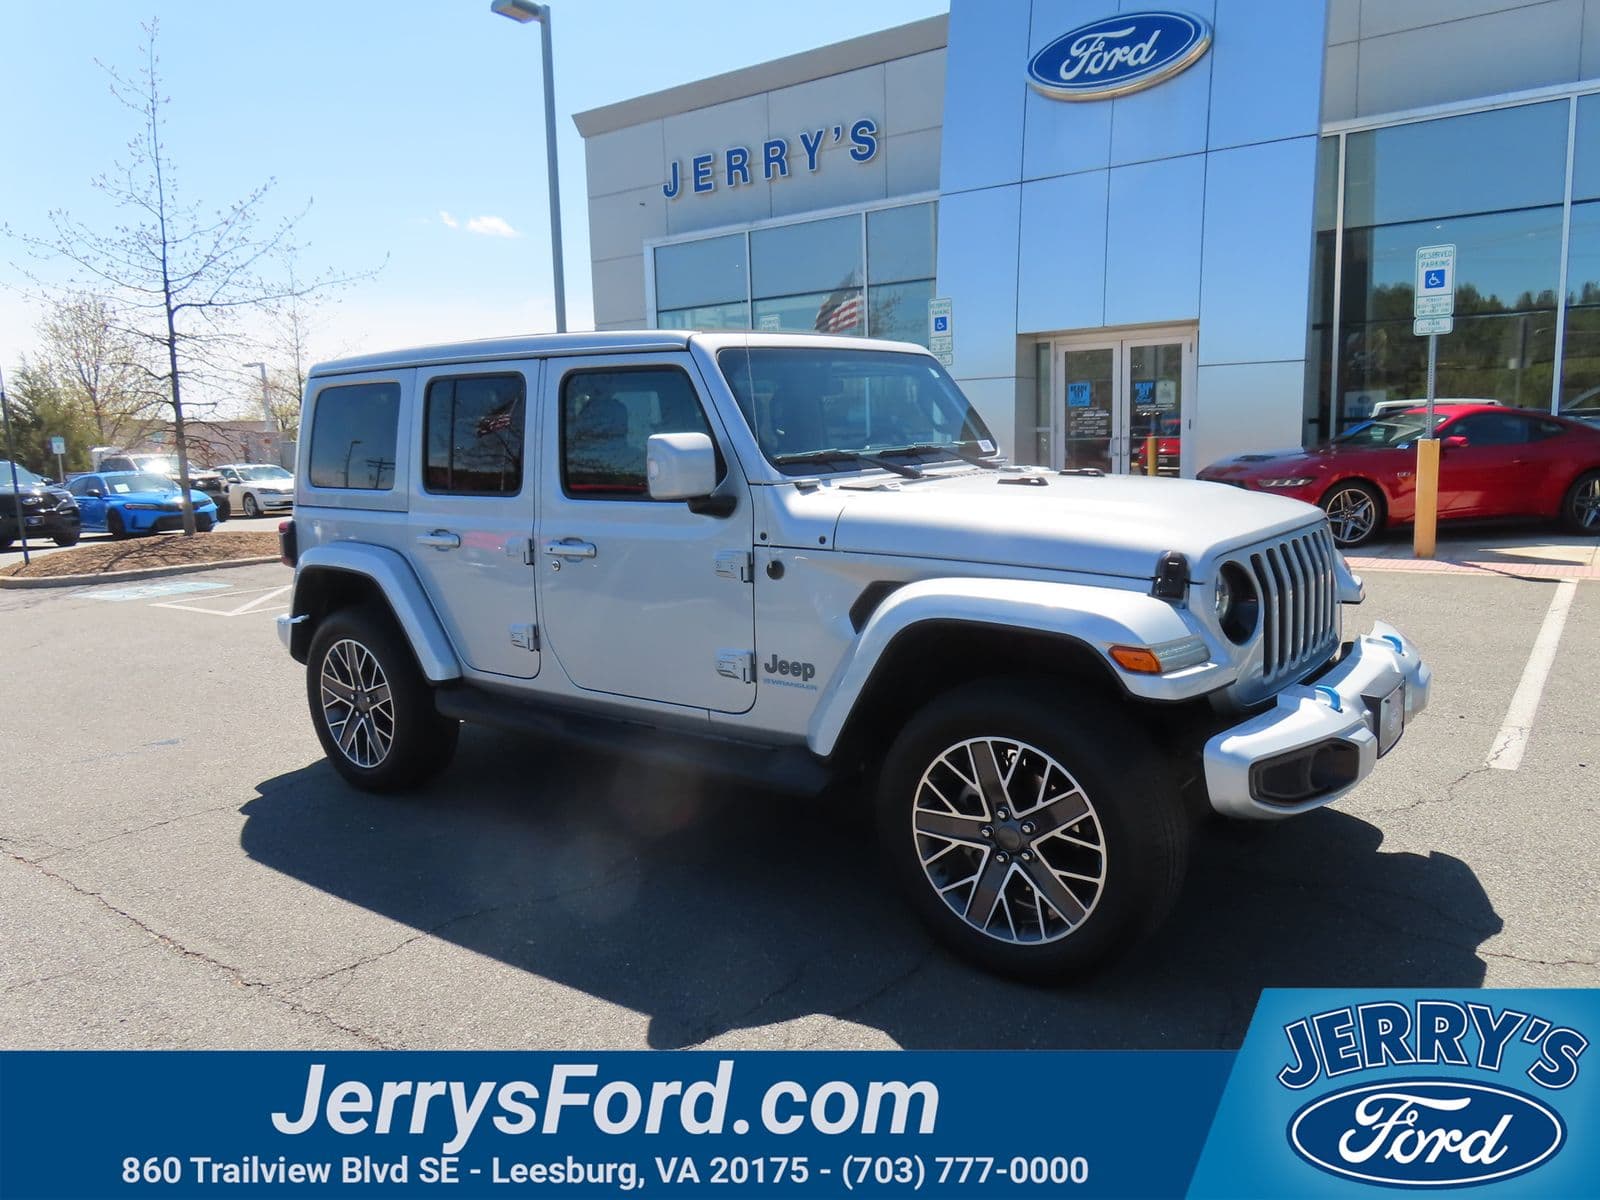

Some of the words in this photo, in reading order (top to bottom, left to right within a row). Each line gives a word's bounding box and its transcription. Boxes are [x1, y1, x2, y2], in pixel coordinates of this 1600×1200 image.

[1059, 26, 1162, 80] Ford
[662, 119, 878, 198] JERRY'S
[1419, 249, 1453, 260] RESERVED
[1420, 259, 1450, 268] PARKING
[764, 654, 816, 681] Jeep
